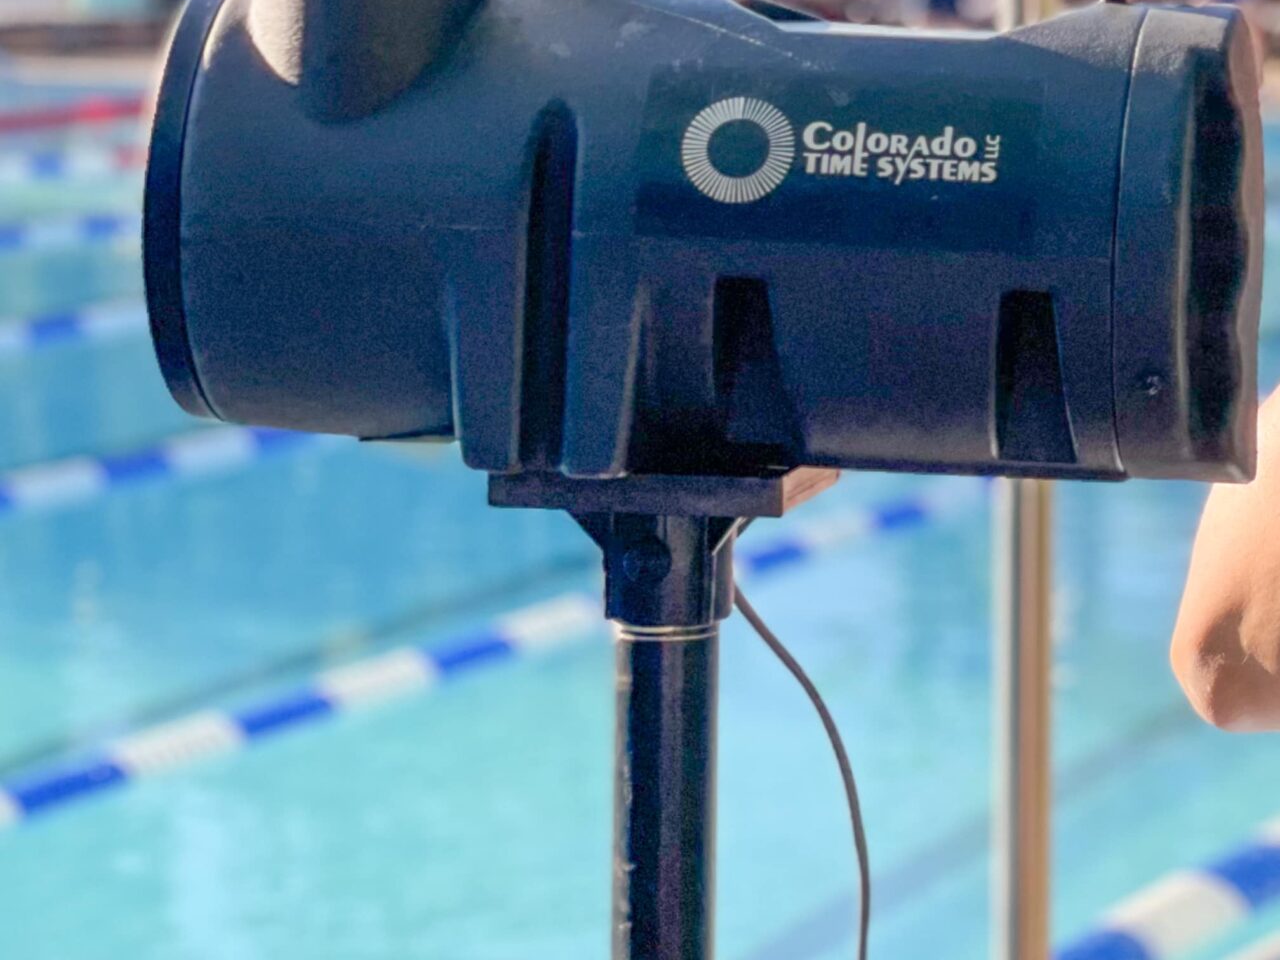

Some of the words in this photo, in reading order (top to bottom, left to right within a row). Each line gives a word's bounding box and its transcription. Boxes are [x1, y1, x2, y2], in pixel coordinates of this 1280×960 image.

[984, 135, 1001, 159] LLC
[802, 152, 868, 177] TIME
[876, 152, 999, 185] SYSTEMS
